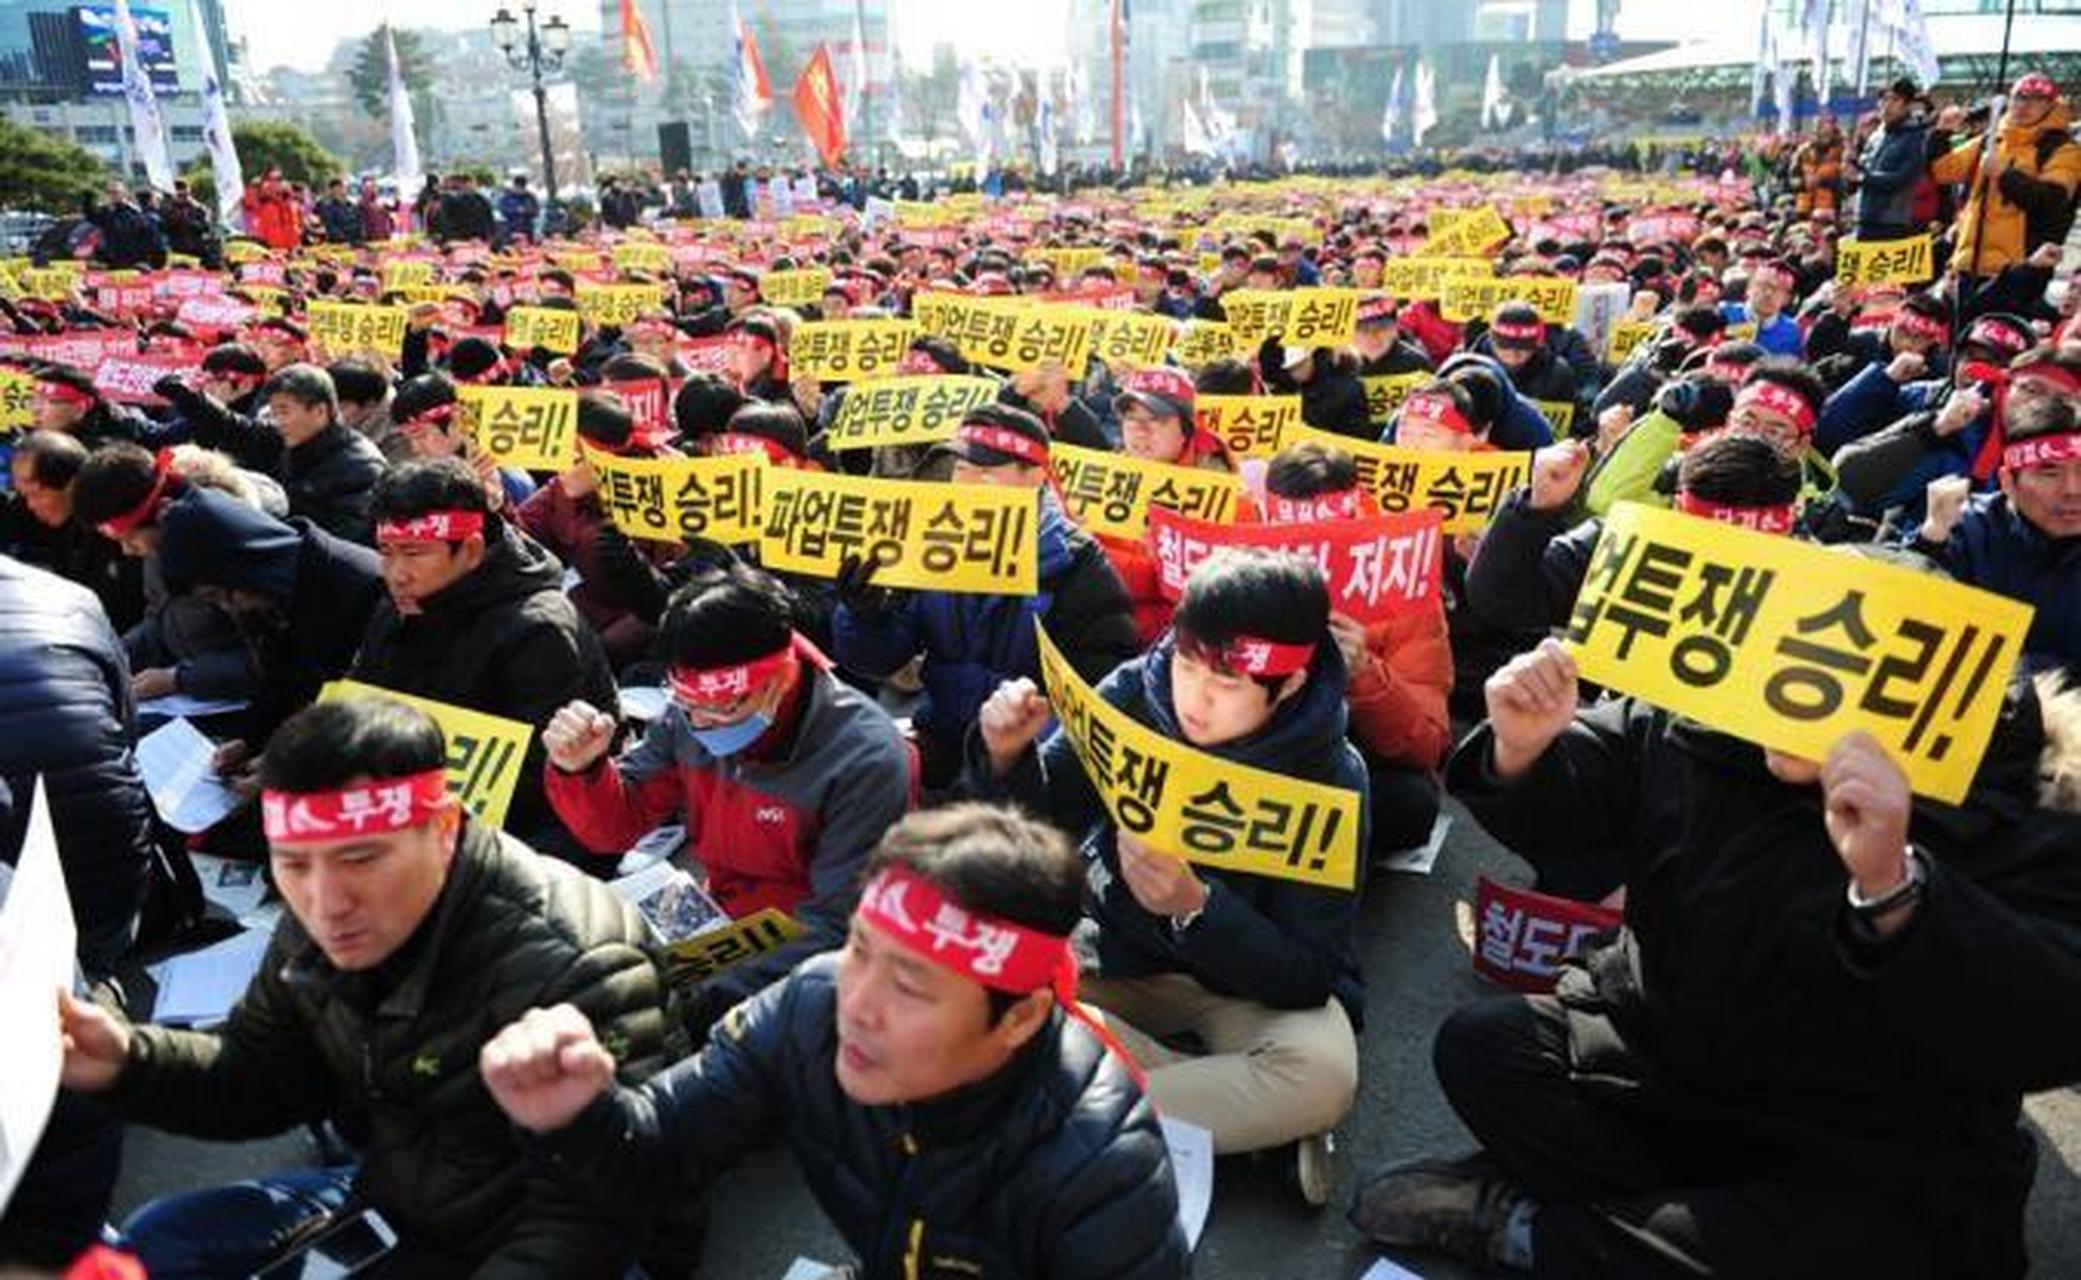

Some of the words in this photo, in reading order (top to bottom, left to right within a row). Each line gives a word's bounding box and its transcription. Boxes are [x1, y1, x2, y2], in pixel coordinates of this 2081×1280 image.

[1866, 243, 1927, 280] 승리!
[358, 312, 403, 345] 승리!
[1018, 319, 1088, 369] 승리!
[1109, 320, 1166, 364] 승리!
[1296, 299, 1354, 339] 승리!
[488, 401, 570, 457] 승리!
[922, 385, 994, 430] 승리!
[674, 466, 762, 534] 승리!
[765, 487, 912, 568] 파업투쟁
[921, 500, 1027, 578] 승리!
[1341, 526, 1438, 607] 저지!
[1763, 588, 2005, 762] 승리!
[337, 783, 412, 830] 투쟁
[1181, 780, 1343, 870] 승리!
[922, 902, 1020, 976] 투쟁
